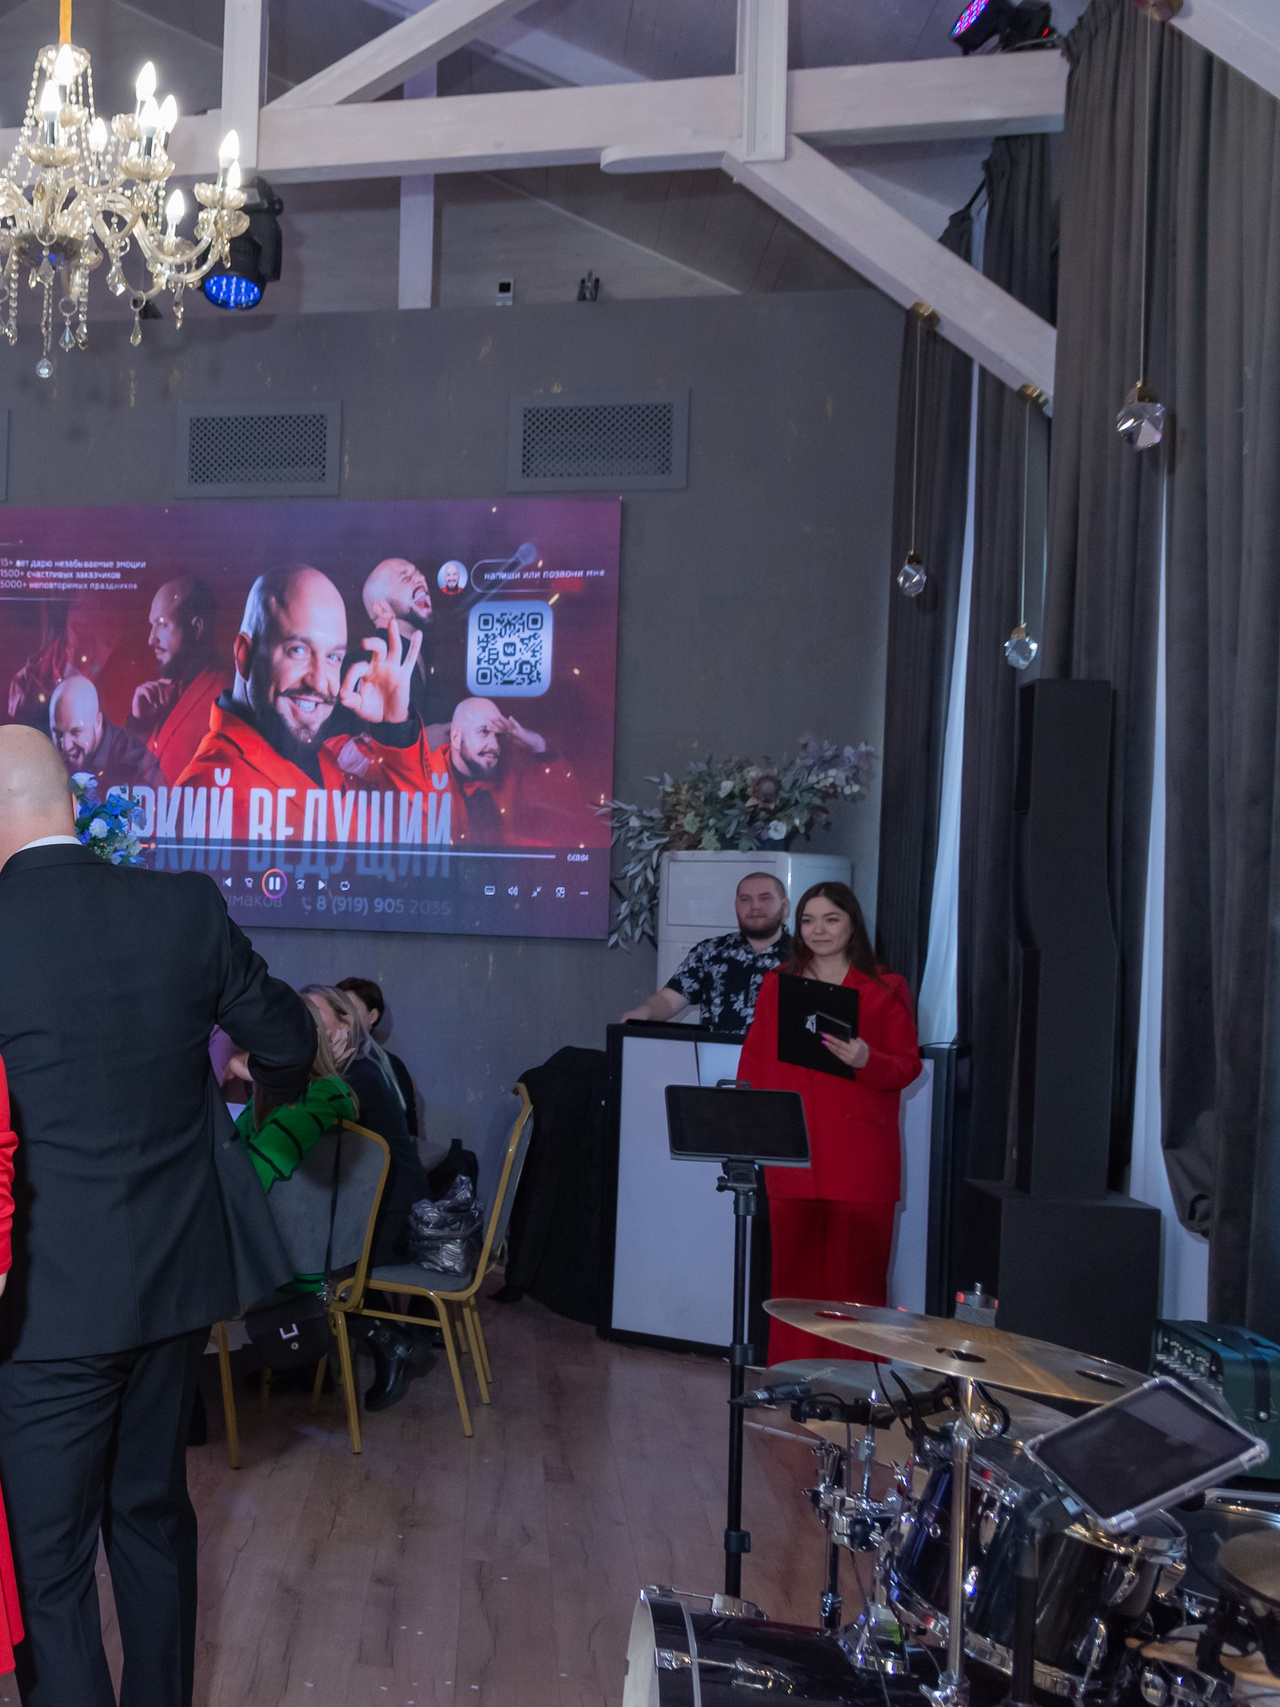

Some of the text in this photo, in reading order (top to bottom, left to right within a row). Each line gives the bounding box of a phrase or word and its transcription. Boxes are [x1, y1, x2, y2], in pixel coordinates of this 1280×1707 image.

[30, 560, 53, 569] дарю
[54, 559, 115, 568] незабываемые
[116, 560, 147, 569] эмоции
[0, 569, 121, 579] 1500+ счастливых заказчиков
[484, 569, 605, 580] напиши или позвони мне
[0, 580, 138, 590] 5000+ неповторимых праздников
[248, 772, 452, 882] ВЕДУЩИЙ
[316, 896, 327, 911] 8
[332, 896, 369, 915] (919)
[373, 898, 404, 914] 905
